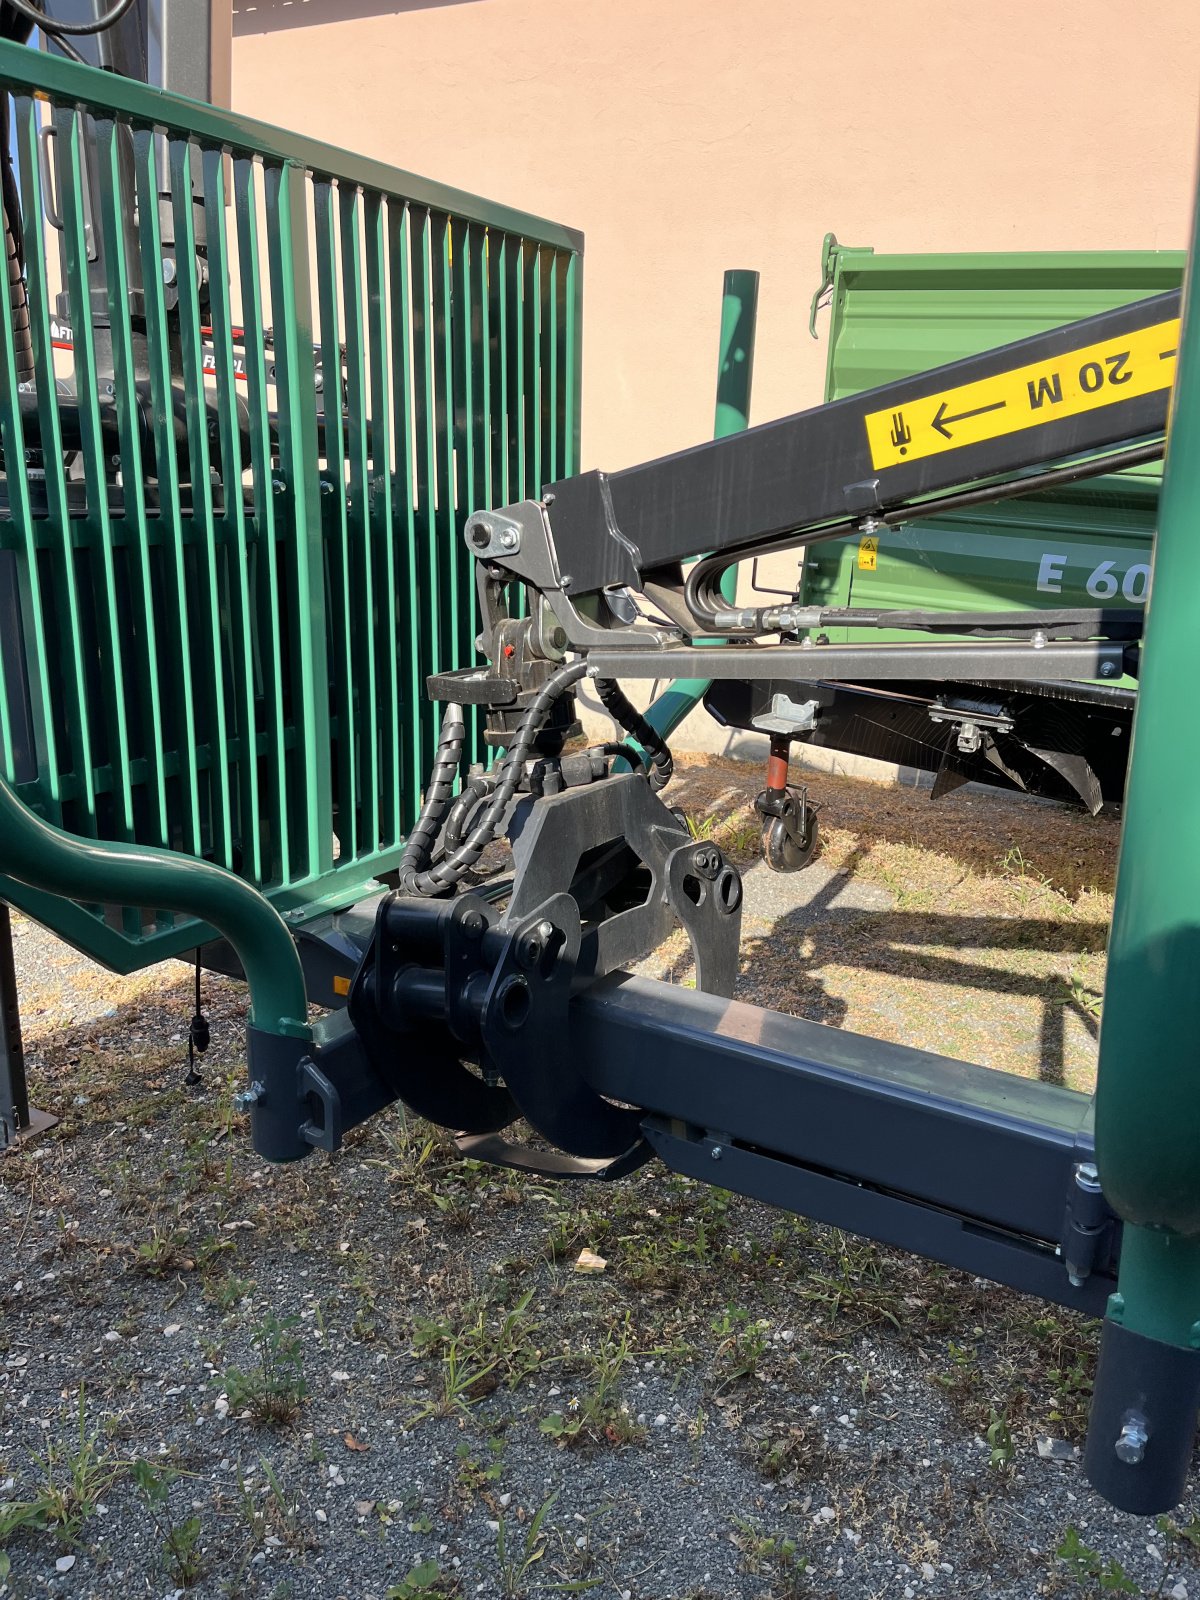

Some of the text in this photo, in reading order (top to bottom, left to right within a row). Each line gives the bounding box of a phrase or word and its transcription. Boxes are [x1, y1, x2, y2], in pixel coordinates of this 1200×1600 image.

[1027, 351, 1133, 410] 20 M
[1037, 553, 1067, 593] E
